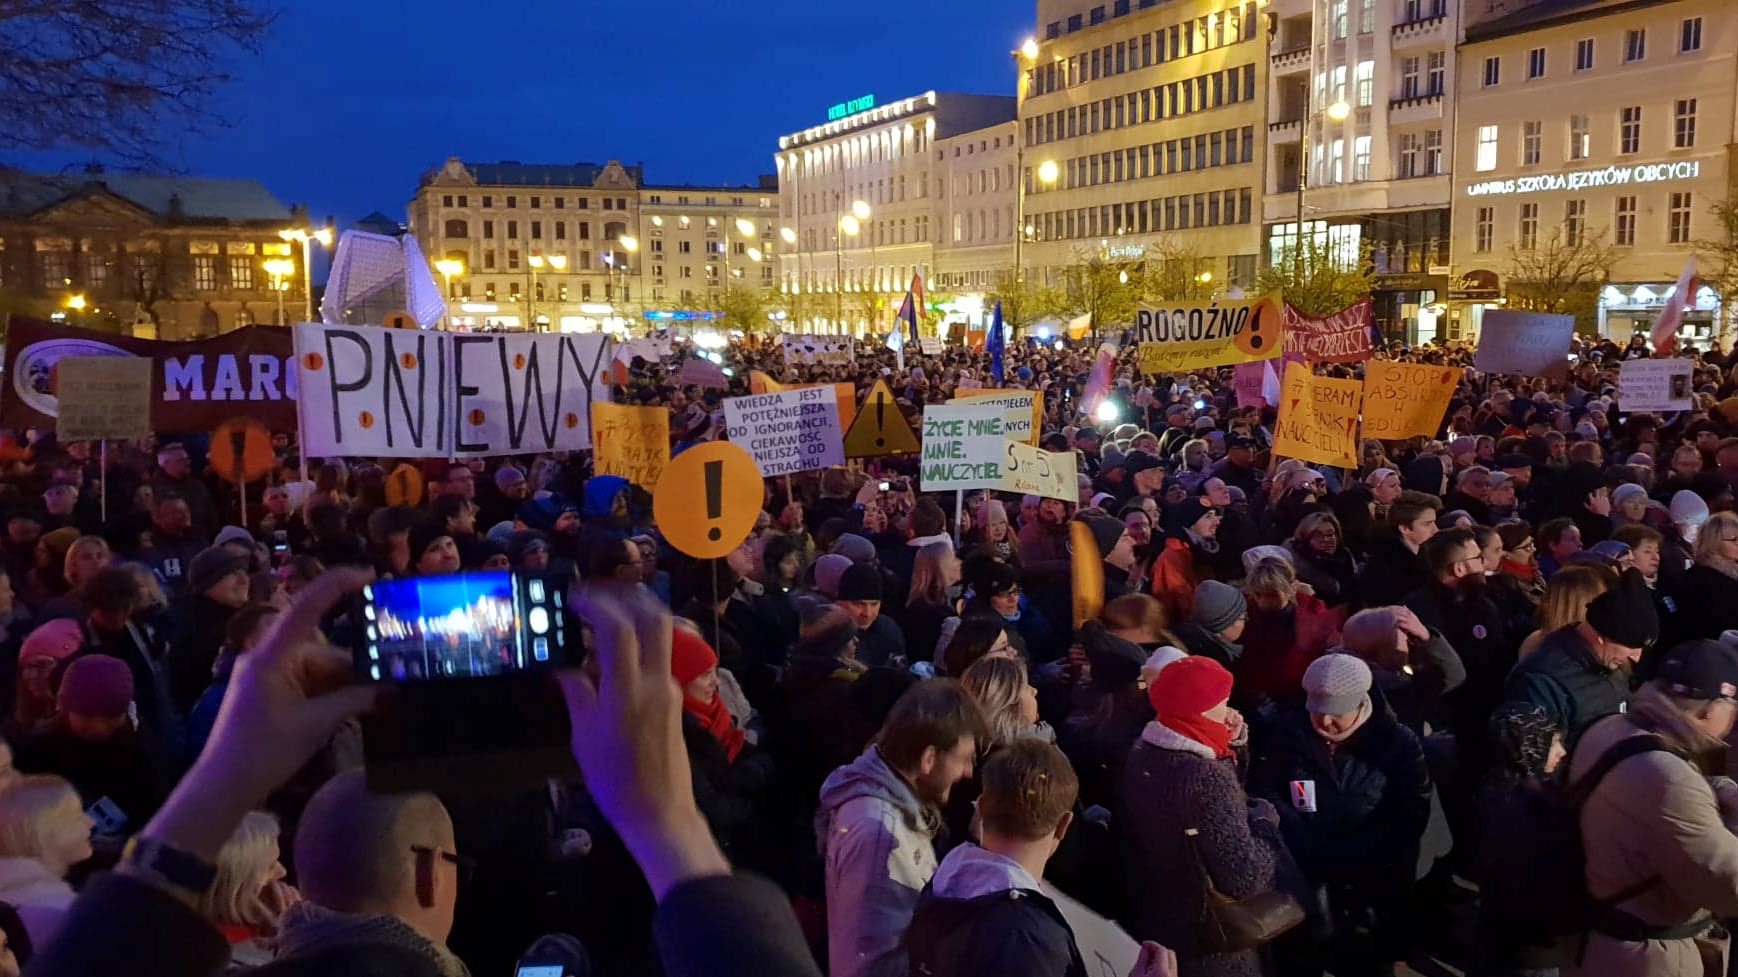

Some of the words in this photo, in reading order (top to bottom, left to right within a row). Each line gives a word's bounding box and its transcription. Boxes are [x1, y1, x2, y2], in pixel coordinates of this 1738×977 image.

[1516, 174, 1567, 194] SZKOŁA
[1566, 164, 1632, 191] JĘZYKÓW
[1633, 160, 1700, 183] OBCYCH
[1137, 303, 1250, 343] ROGOŹNO
[1384, 366, 1441, 387] STOP
[324, 329, 610, 452] PNIEWY
[734, 394, 784, 410] WIEDZA
[799, 389, 824, 402] JEST
[741, 403, 826, 424] POTĘŻNIEJSZA
[728, 426, 748, 438] OD
[754, 417, 833, 435] IGNORANCJI,
[924, 416, 965, 438] ŻYCIE
[1004, 421, 1031, 432] NYCH
[807, 443, 827, 455] OD
[763, 457, 821, 476] STRACHU
